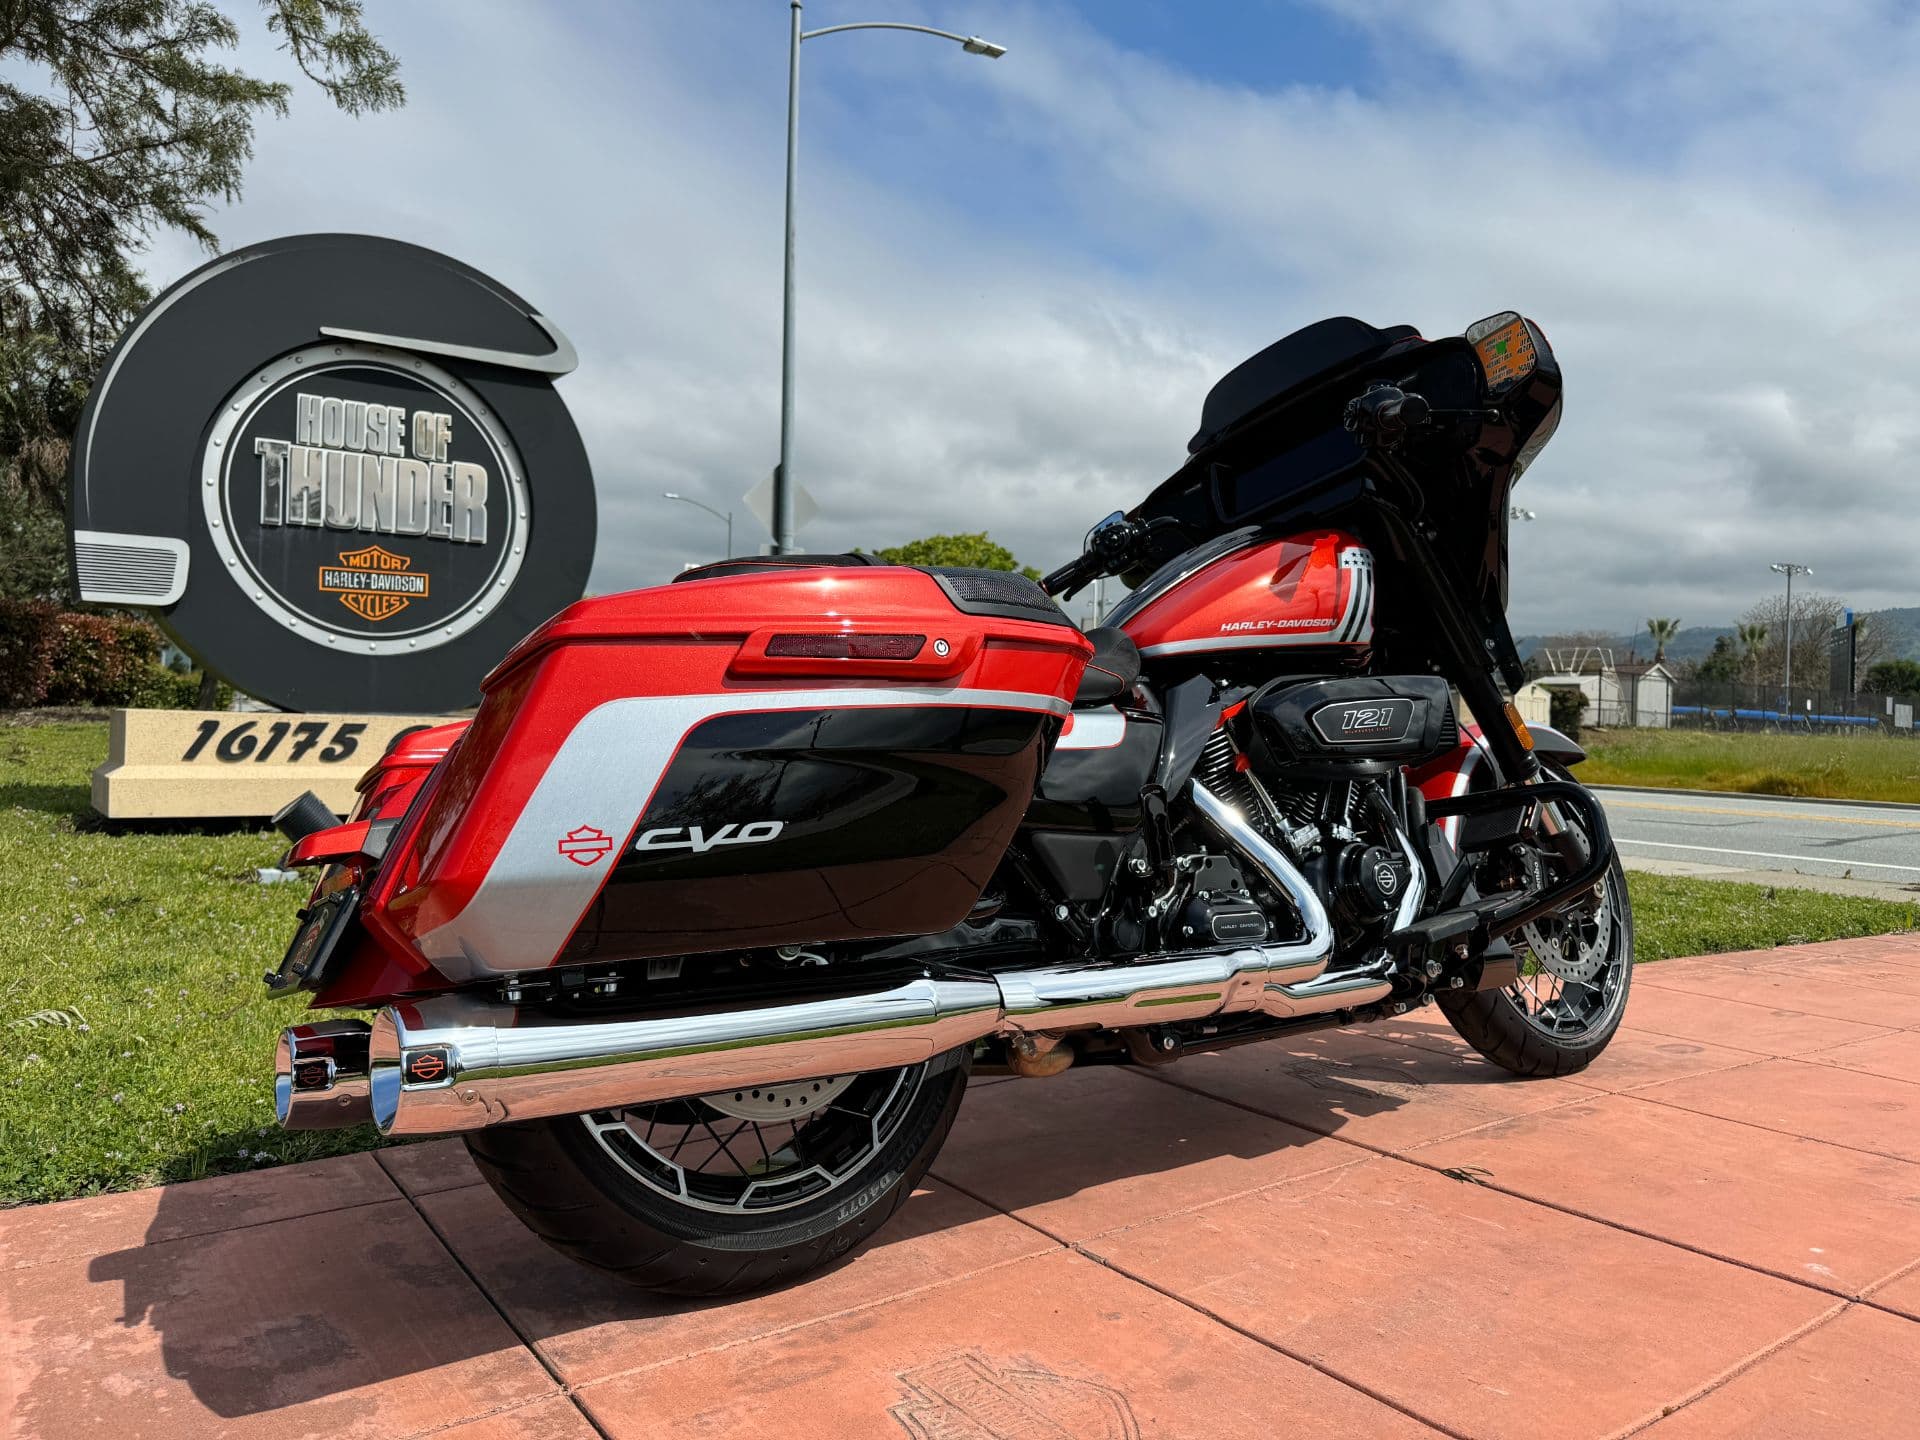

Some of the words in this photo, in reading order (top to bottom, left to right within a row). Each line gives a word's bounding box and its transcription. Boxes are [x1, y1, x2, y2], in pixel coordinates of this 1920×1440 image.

[297, 393, 405, 457] HOUSE
[412, 411, 452, 462] OF
[255, 437, 488, 544] THUNDER
[349, 550, 401, 570] MOTOR
[324, 570, 424, 592] HARLEY-DAVIDSON
[348, 593, 400, 616] CYCLES
[1221, 618, 1337, 631] HARLEY-DAVIDSON
[1341, 707, 1394, 729] 121
[181, 720, 368, 763] 16175
